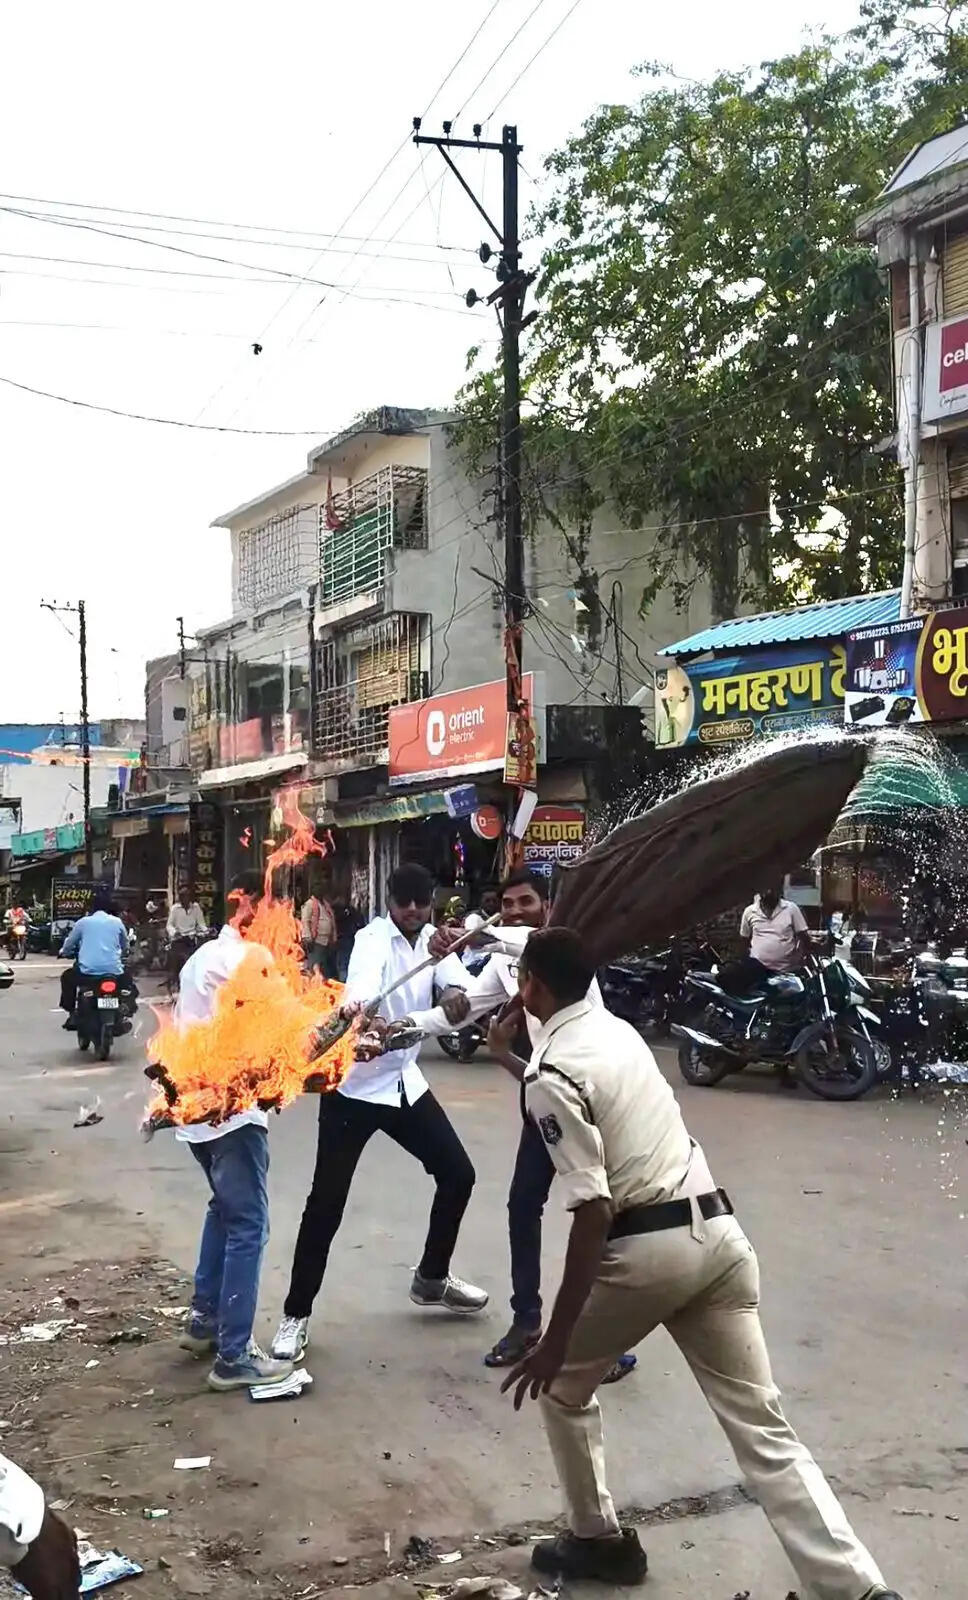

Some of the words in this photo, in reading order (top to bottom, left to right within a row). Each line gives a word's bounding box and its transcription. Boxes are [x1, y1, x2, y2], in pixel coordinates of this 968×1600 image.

[701, 660, 824, 715] मनहरण
[449, 705, 485, 730] orient
[449, 729, 475, 745] electric
